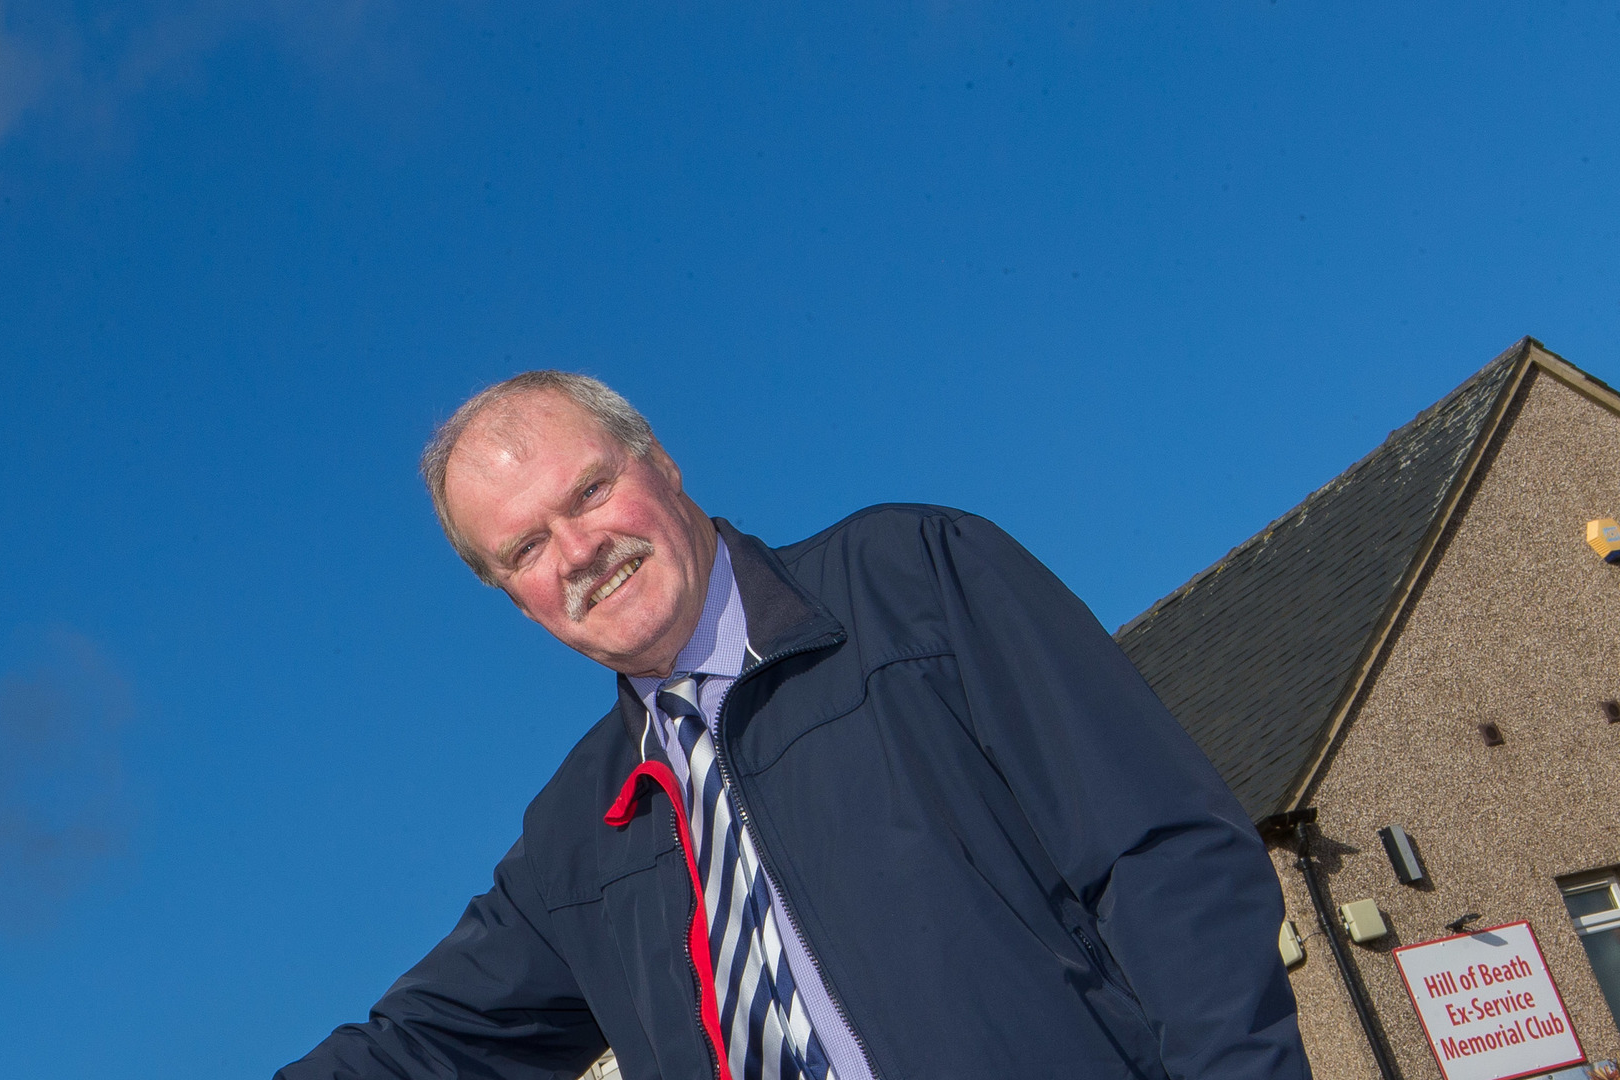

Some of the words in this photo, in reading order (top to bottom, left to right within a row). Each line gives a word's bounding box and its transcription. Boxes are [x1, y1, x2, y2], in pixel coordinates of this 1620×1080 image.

[1423, 971, 1458, 999] Hill
[1459, 965, 1478, 991] of
[1477, 955, 1533, 986] Beath
[1445, 989, 1536, 1027] Ex-Service
[1440, 1020, 1526, 1061] Memorial
[1525, 1012, 1565, 1039] Club
